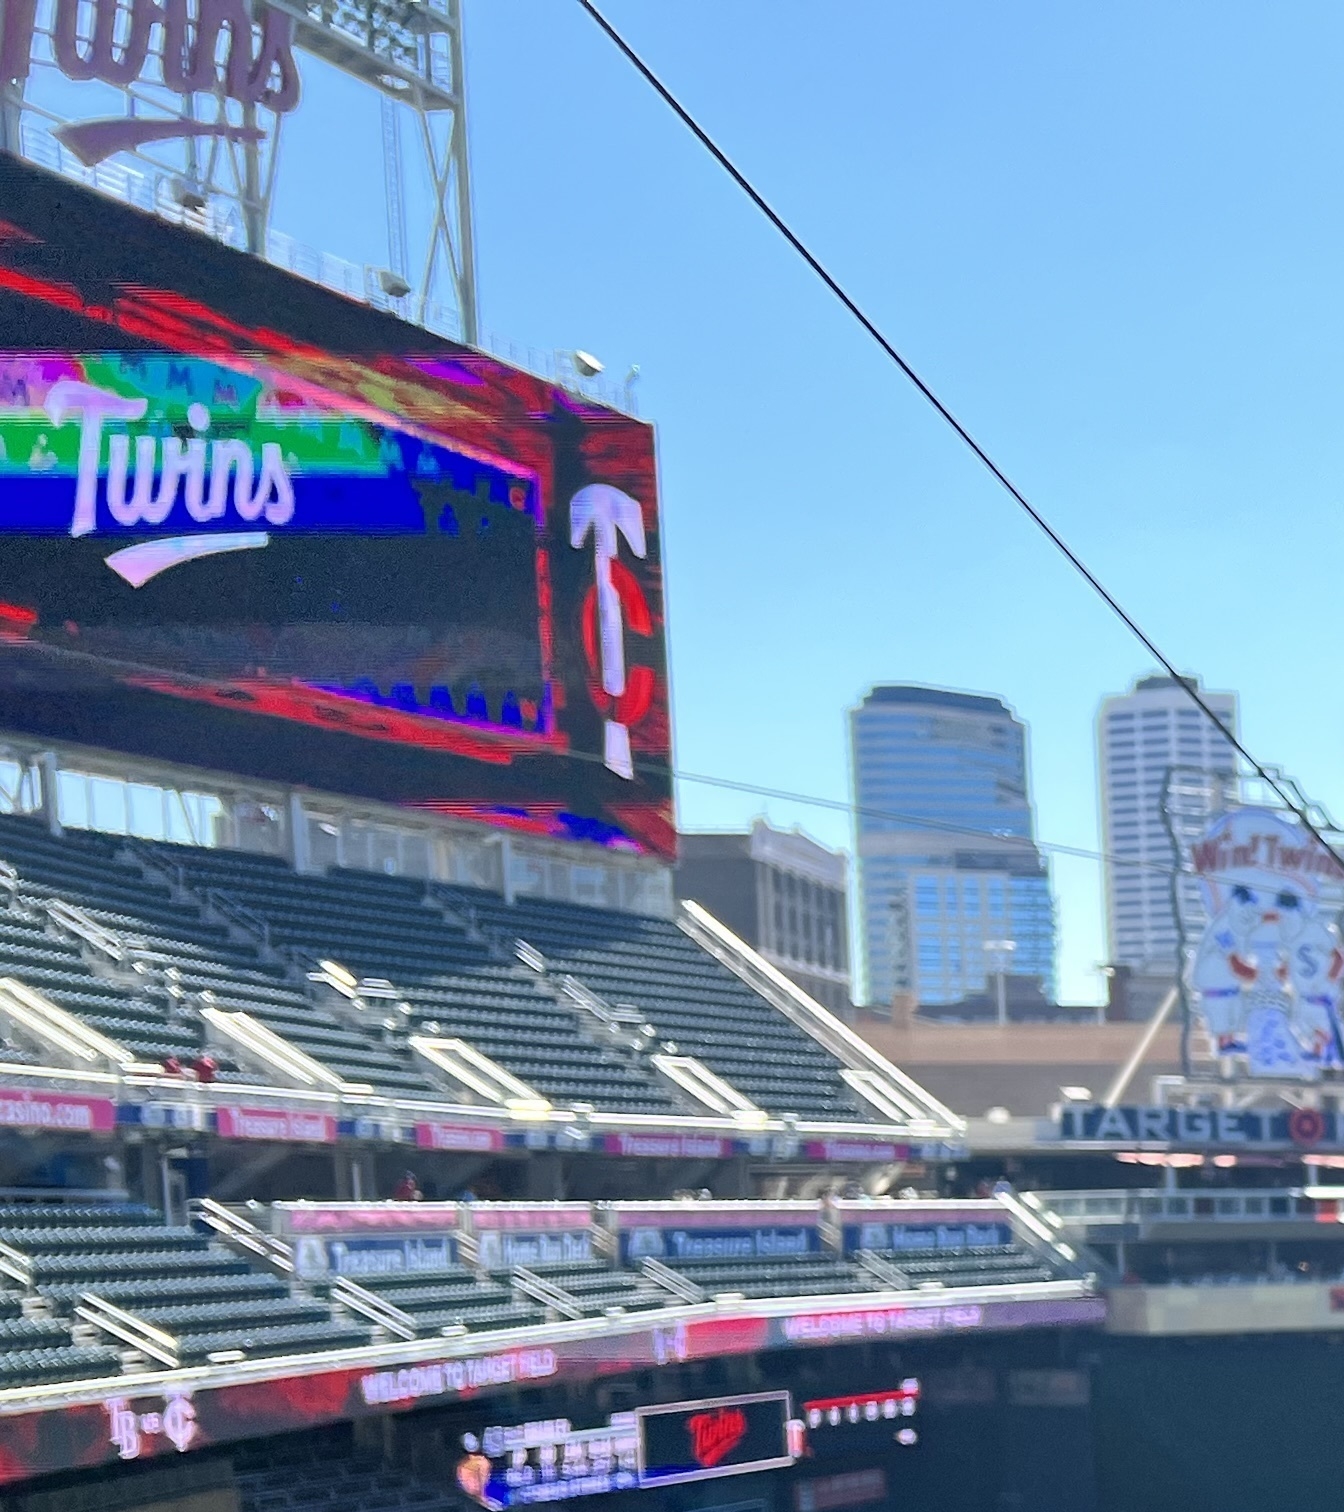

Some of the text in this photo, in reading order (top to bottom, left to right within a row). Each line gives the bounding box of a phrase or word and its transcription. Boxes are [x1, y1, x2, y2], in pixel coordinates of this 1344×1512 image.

[44, 379, 296, 538] Twins
[1064, 1106, 1283, 1142] TARGET
[331, 1238, 451, 1272] Treasure Island
[674, 1229, 809, 1257] Treasure Island
[783, 1313, 864, 1340] WELCOME
[865, 1311, 888, 1334] TO
[361, 1349, 557, 1405] WELCOME TO TARGET FIELD
